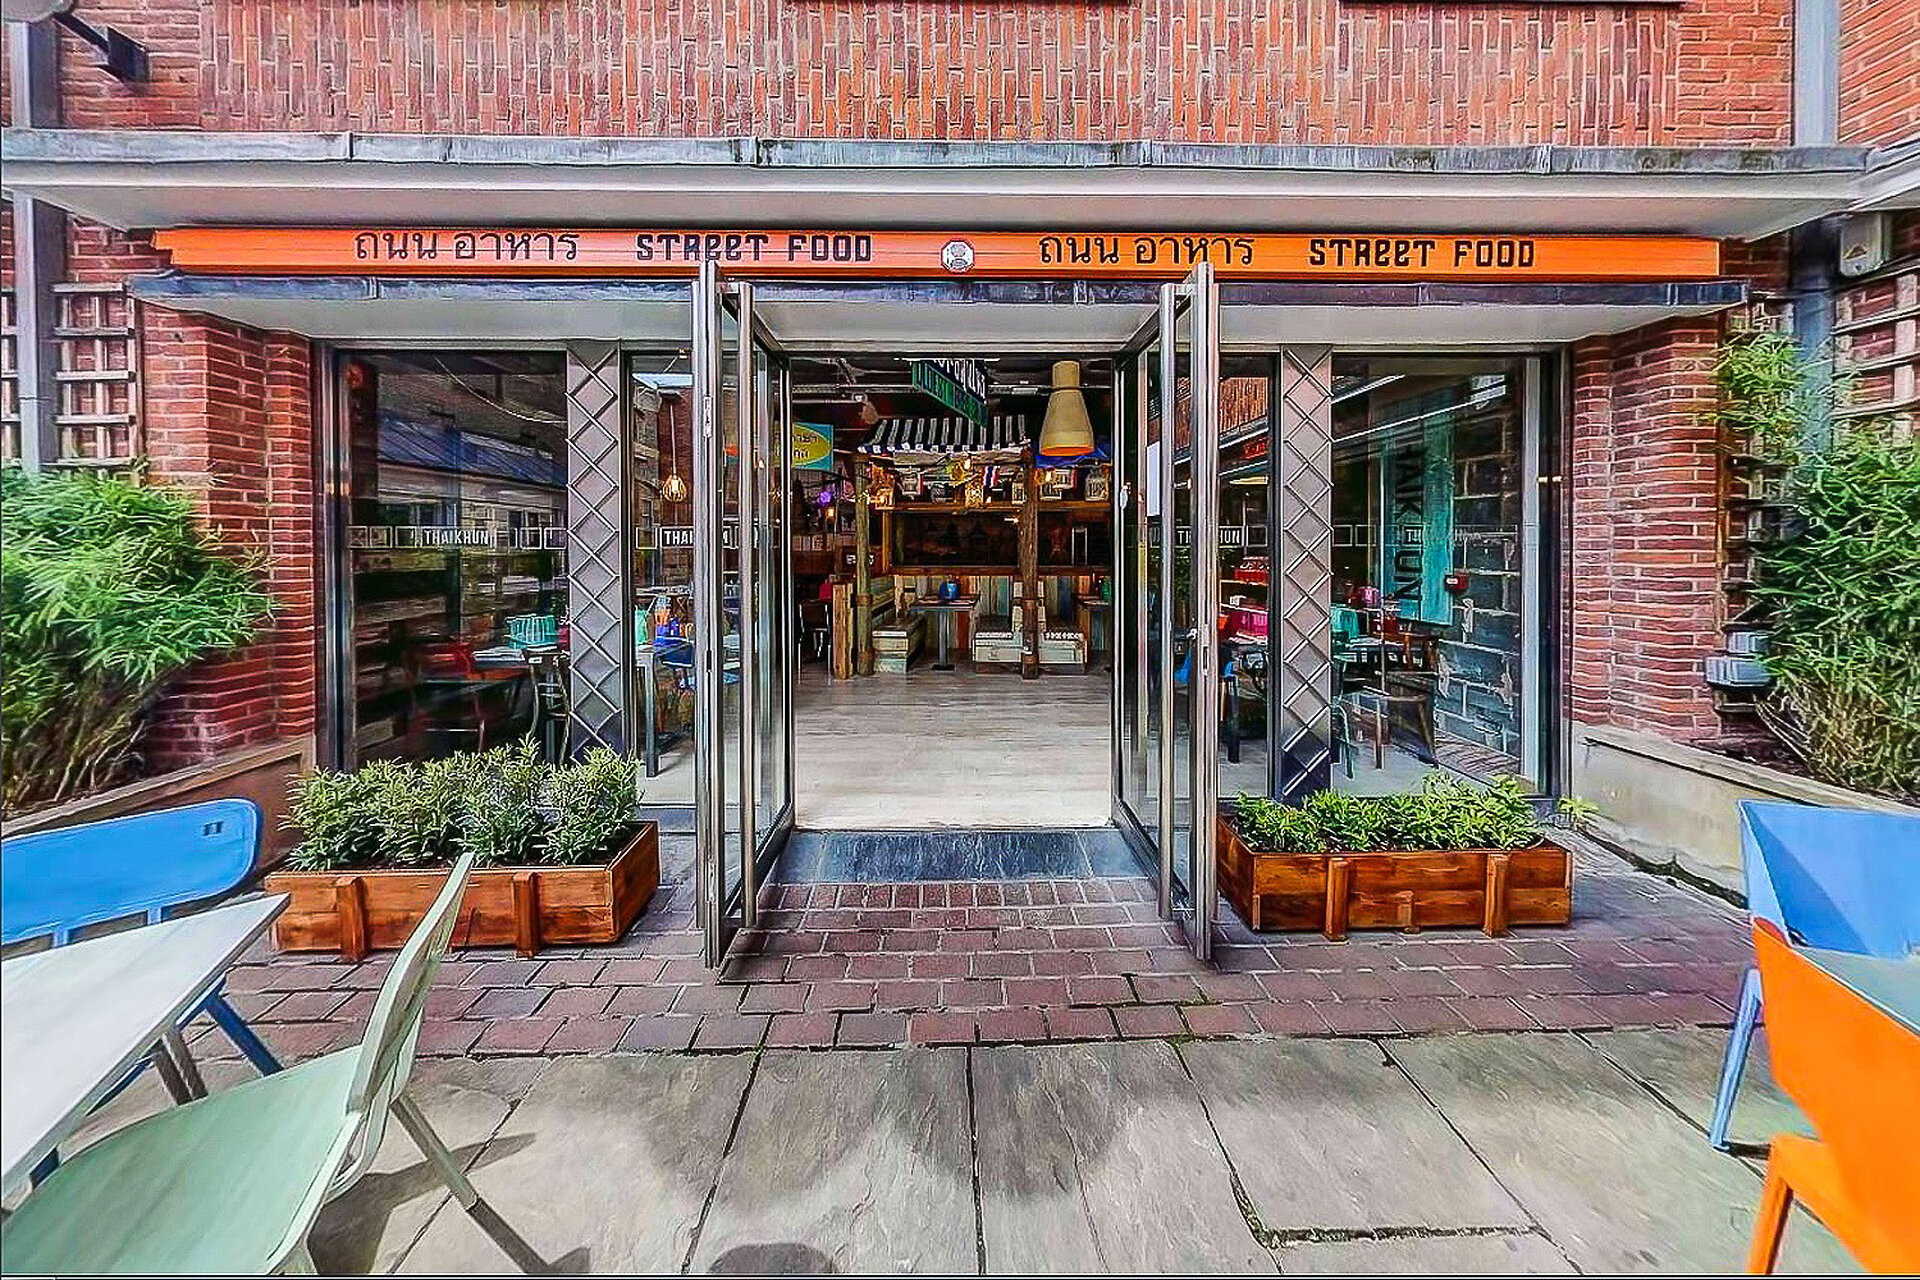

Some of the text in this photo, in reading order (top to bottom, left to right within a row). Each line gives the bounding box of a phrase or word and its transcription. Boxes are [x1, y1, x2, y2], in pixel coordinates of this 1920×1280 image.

[355, 232, 580, 260] ถนน อาหาร
[636, 233, 872, 262] STREET FOOD
[1039, 236, 1255, 265] ถนน อาหาร
[1309, 238, 1535, 268] STREET FOOD
[424, 529, 489, 545] THAIKHUN
